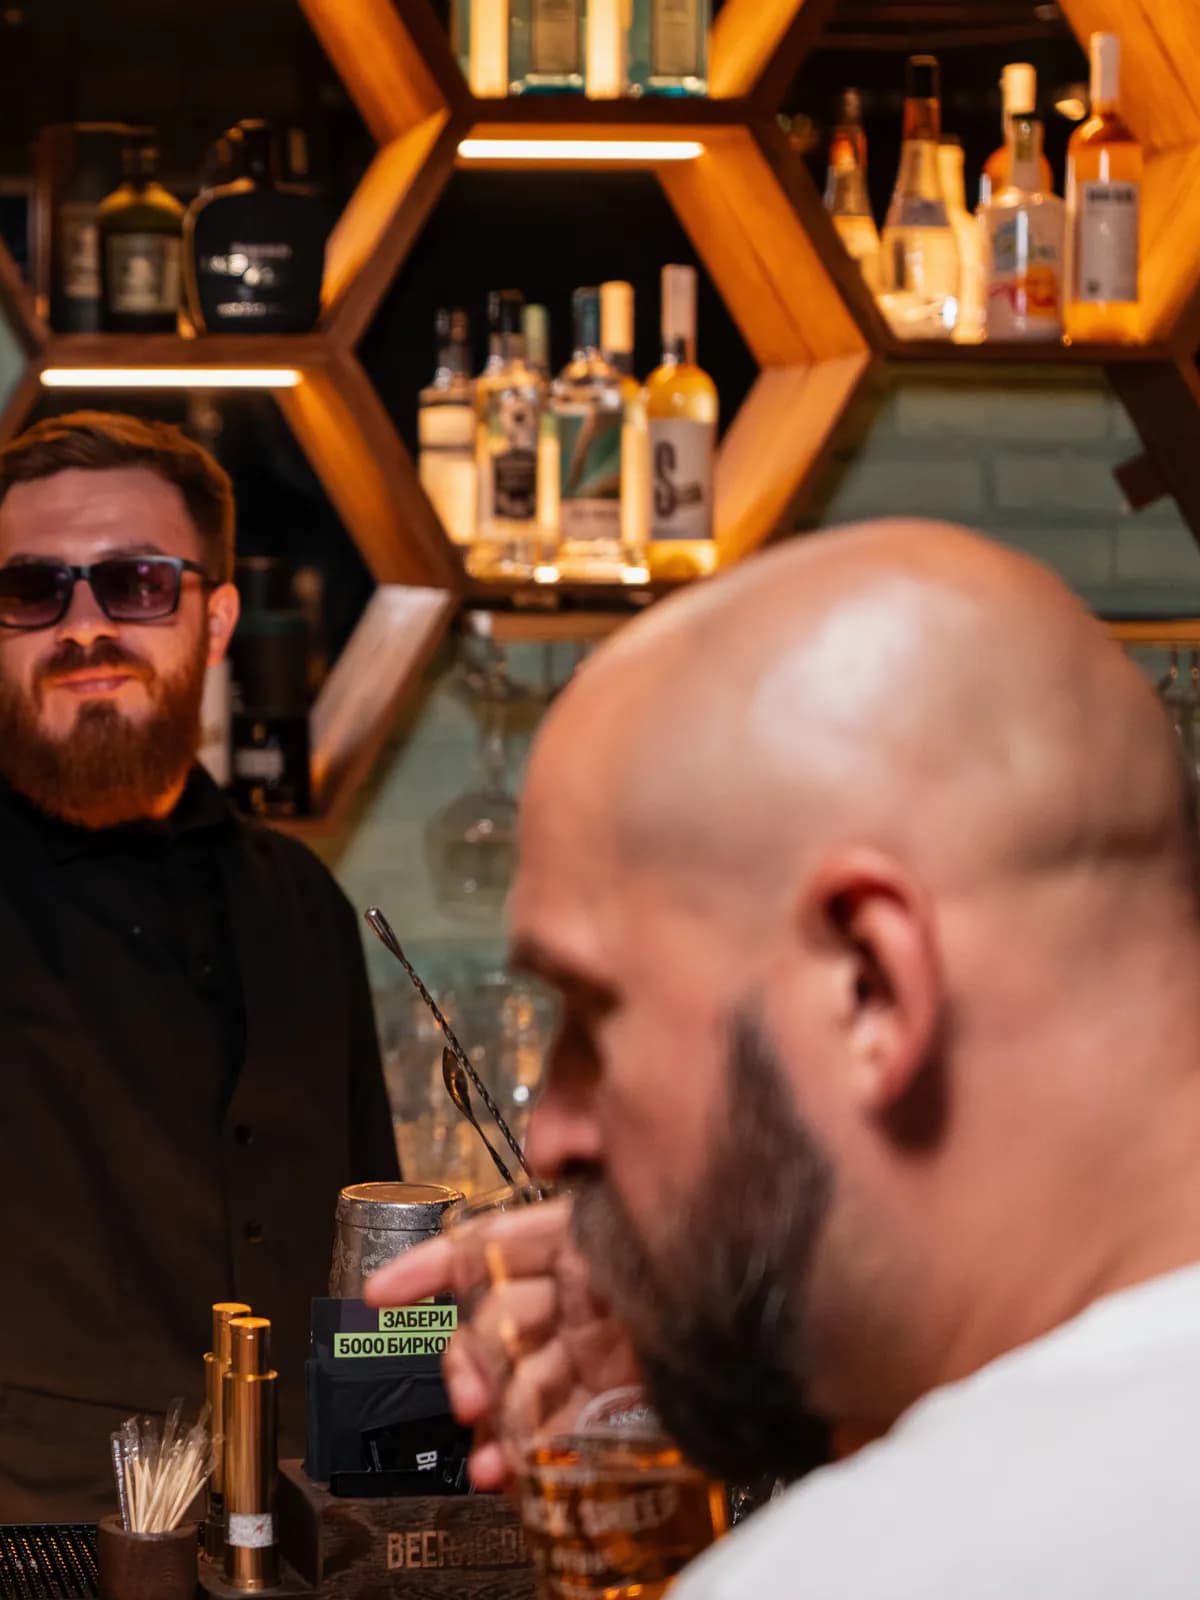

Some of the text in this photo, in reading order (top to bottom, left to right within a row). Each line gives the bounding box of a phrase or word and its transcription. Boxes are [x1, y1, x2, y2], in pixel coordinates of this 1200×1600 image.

[383, 1310, 452, 1328] ЗАБЕРИ
[339, 1336, 451, 1354] 5000 БИРКО
